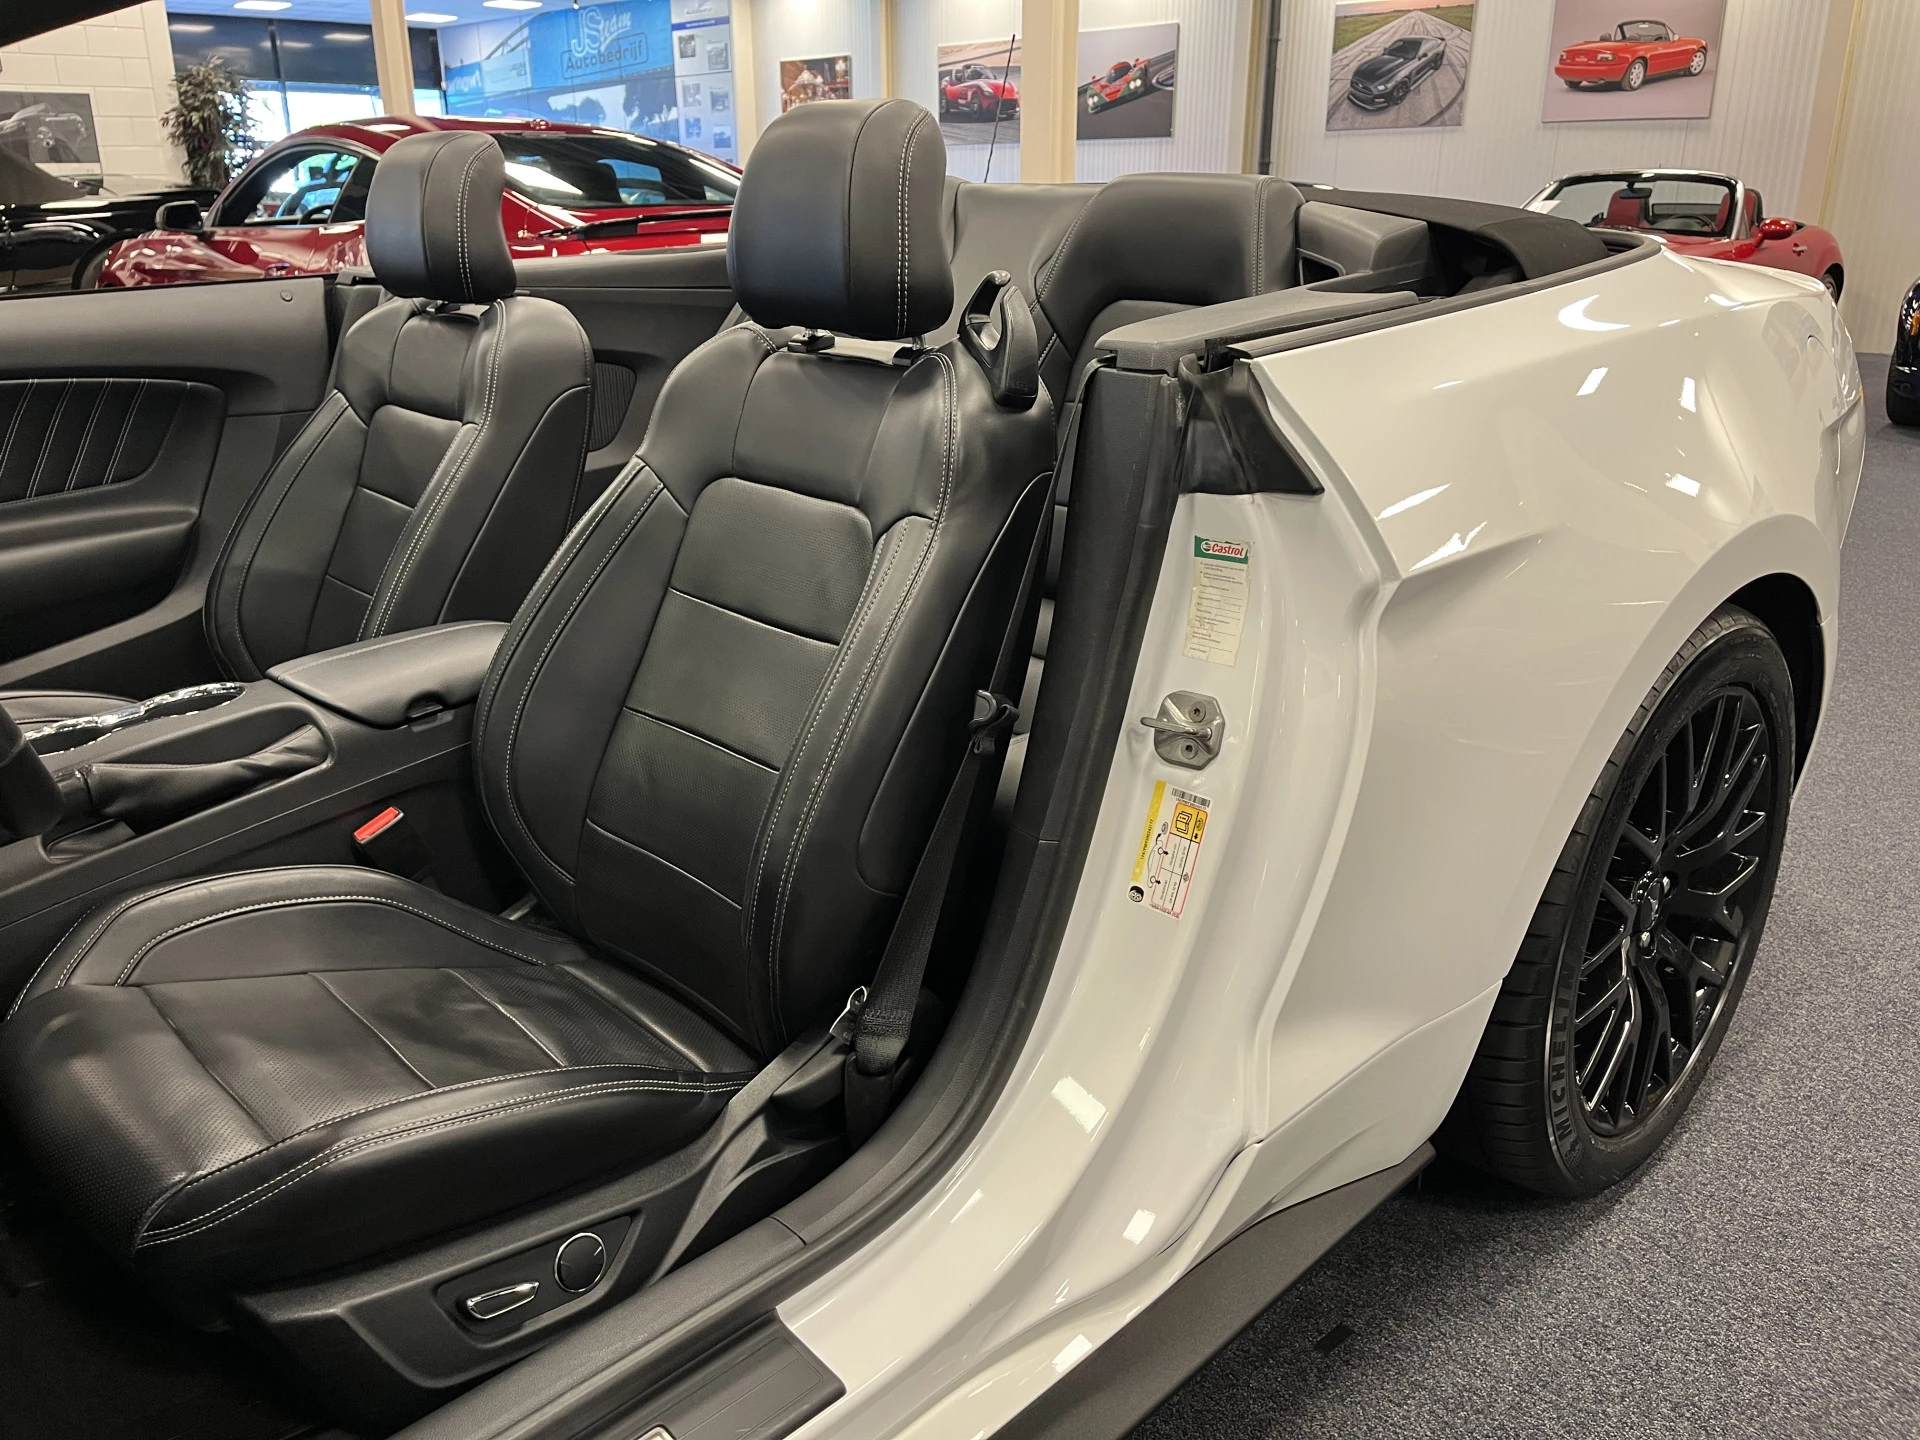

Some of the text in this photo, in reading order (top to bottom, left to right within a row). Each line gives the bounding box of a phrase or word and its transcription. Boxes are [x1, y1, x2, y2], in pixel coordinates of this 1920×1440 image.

[565, 39, 645, 72] Autobedrijf
[1211, 543, 1244, 556] Castrol
[1551, 965, 1575, 1141] MICHELIN
